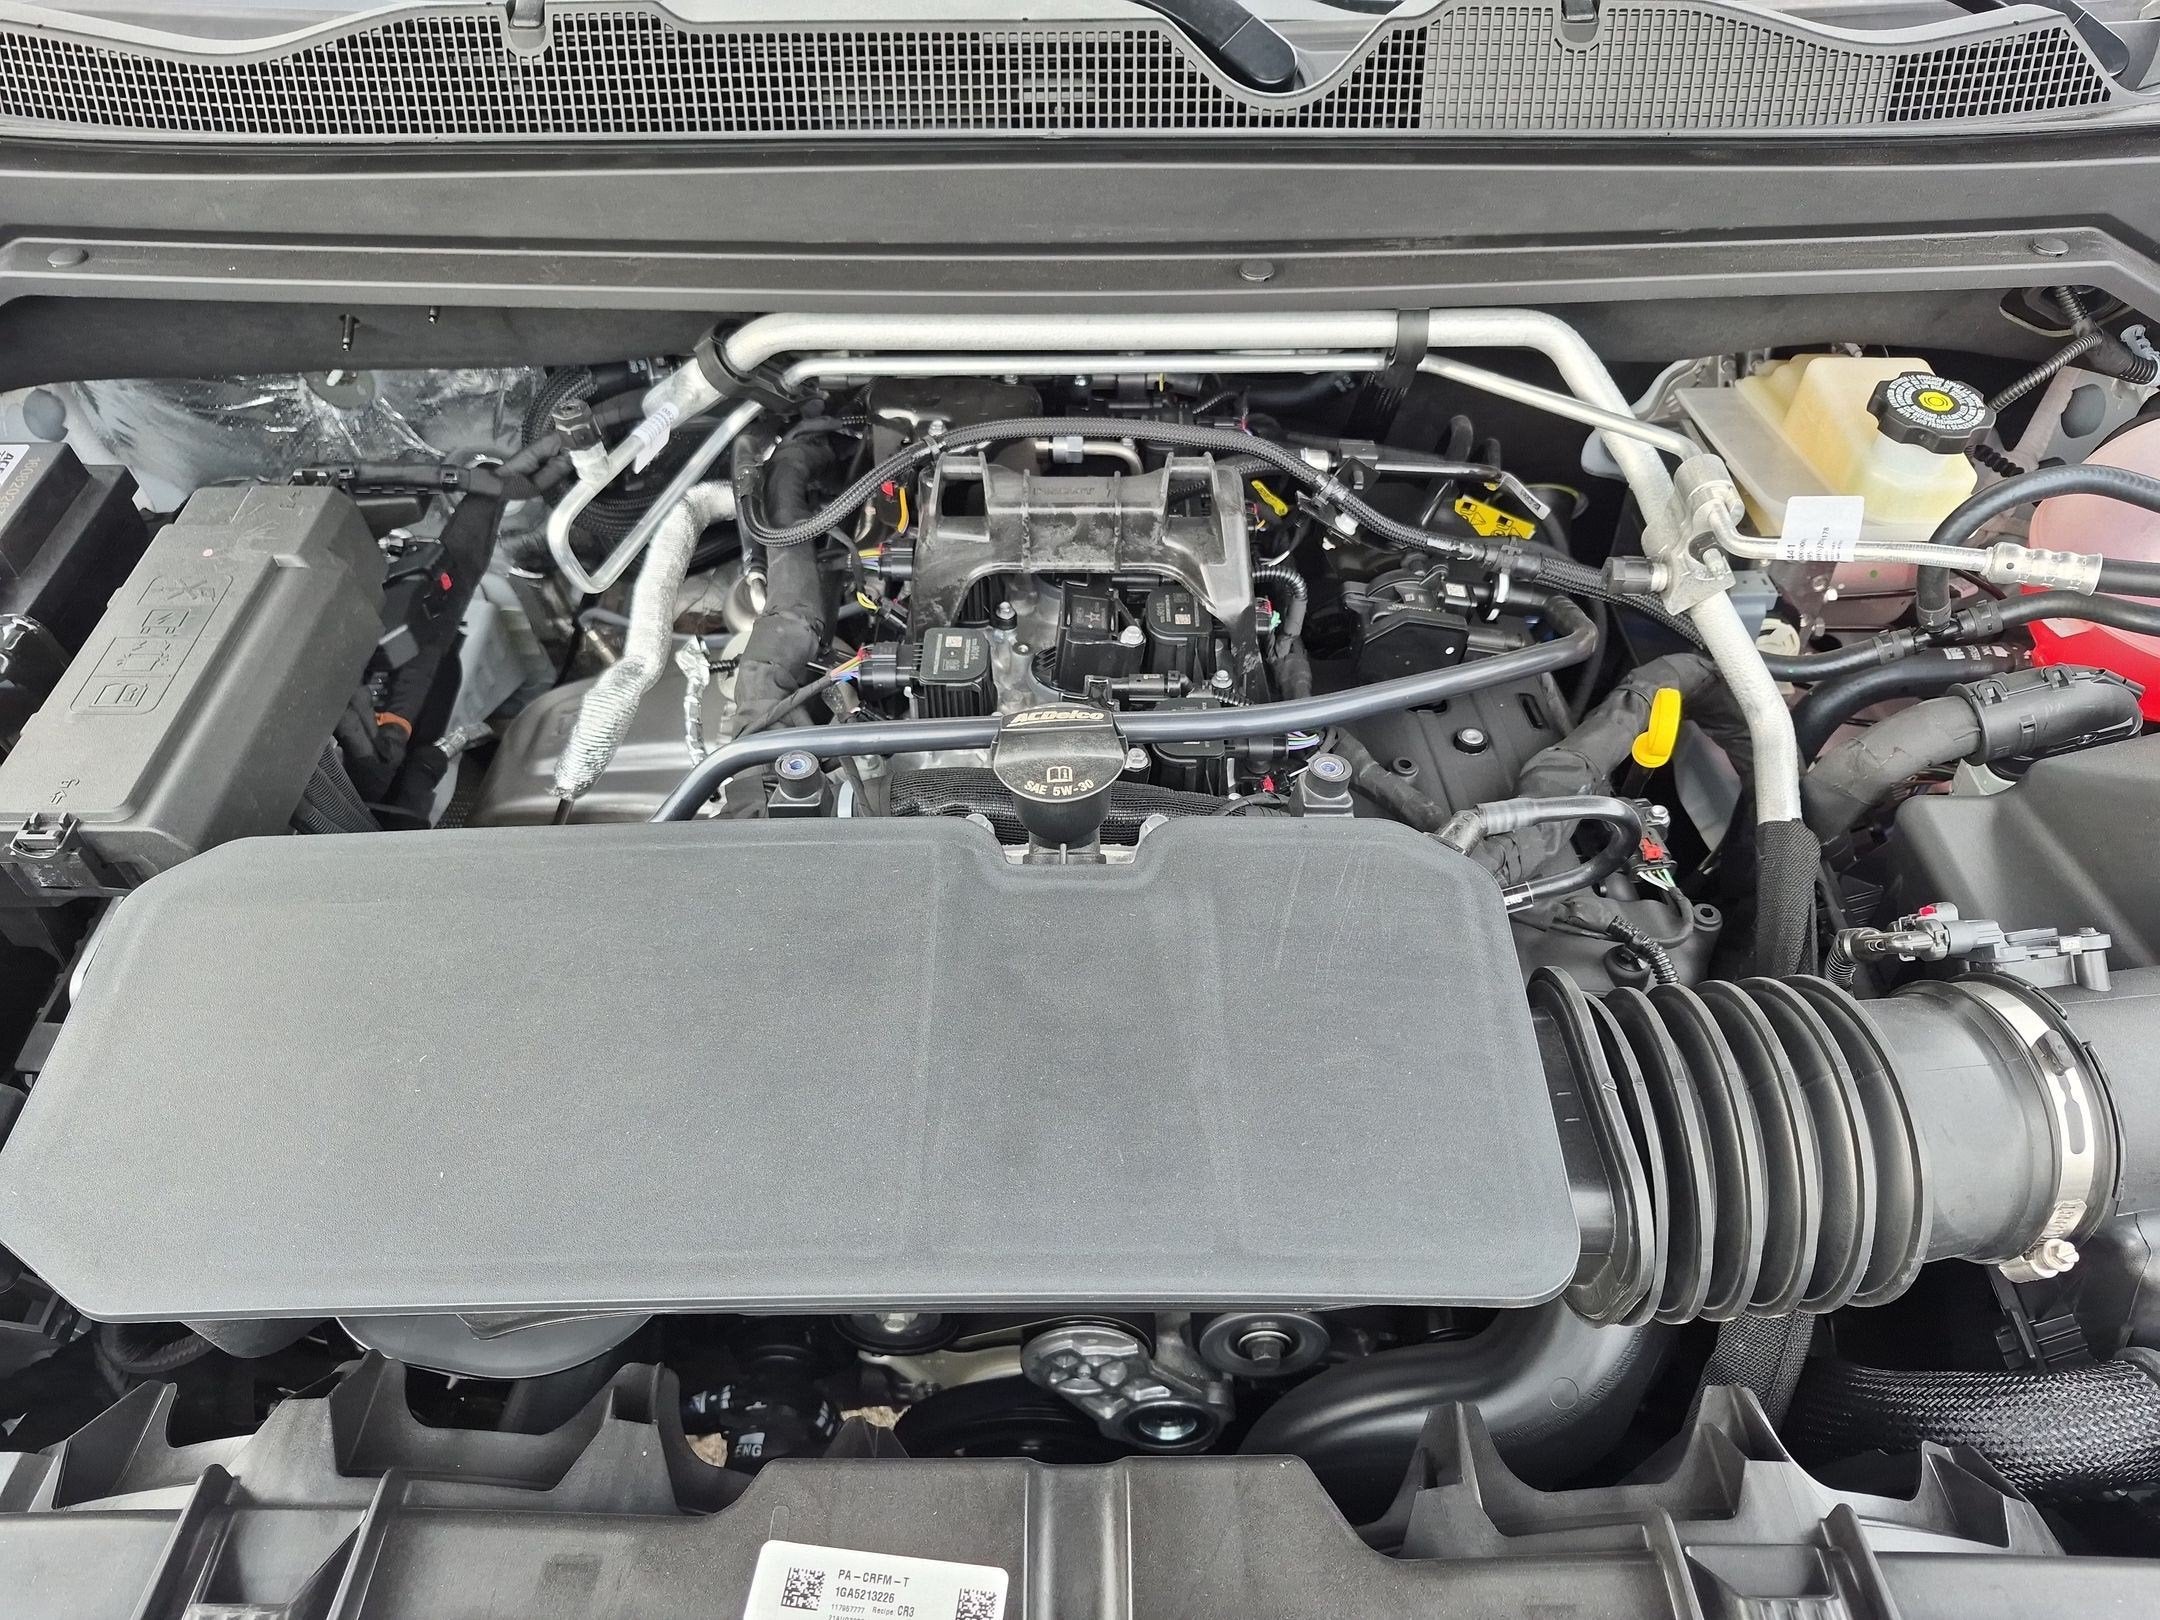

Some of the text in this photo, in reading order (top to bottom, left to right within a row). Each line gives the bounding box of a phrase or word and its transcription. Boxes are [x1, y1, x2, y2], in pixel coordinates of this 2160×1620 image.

[1009, 710, 1105, 724] ACDelco
[1024, 779, 1095, 796] SAE 5W-30
[835, 1586, 895, 1604] 1GA5213226
[897, 1605, 915, 1618] CR3
